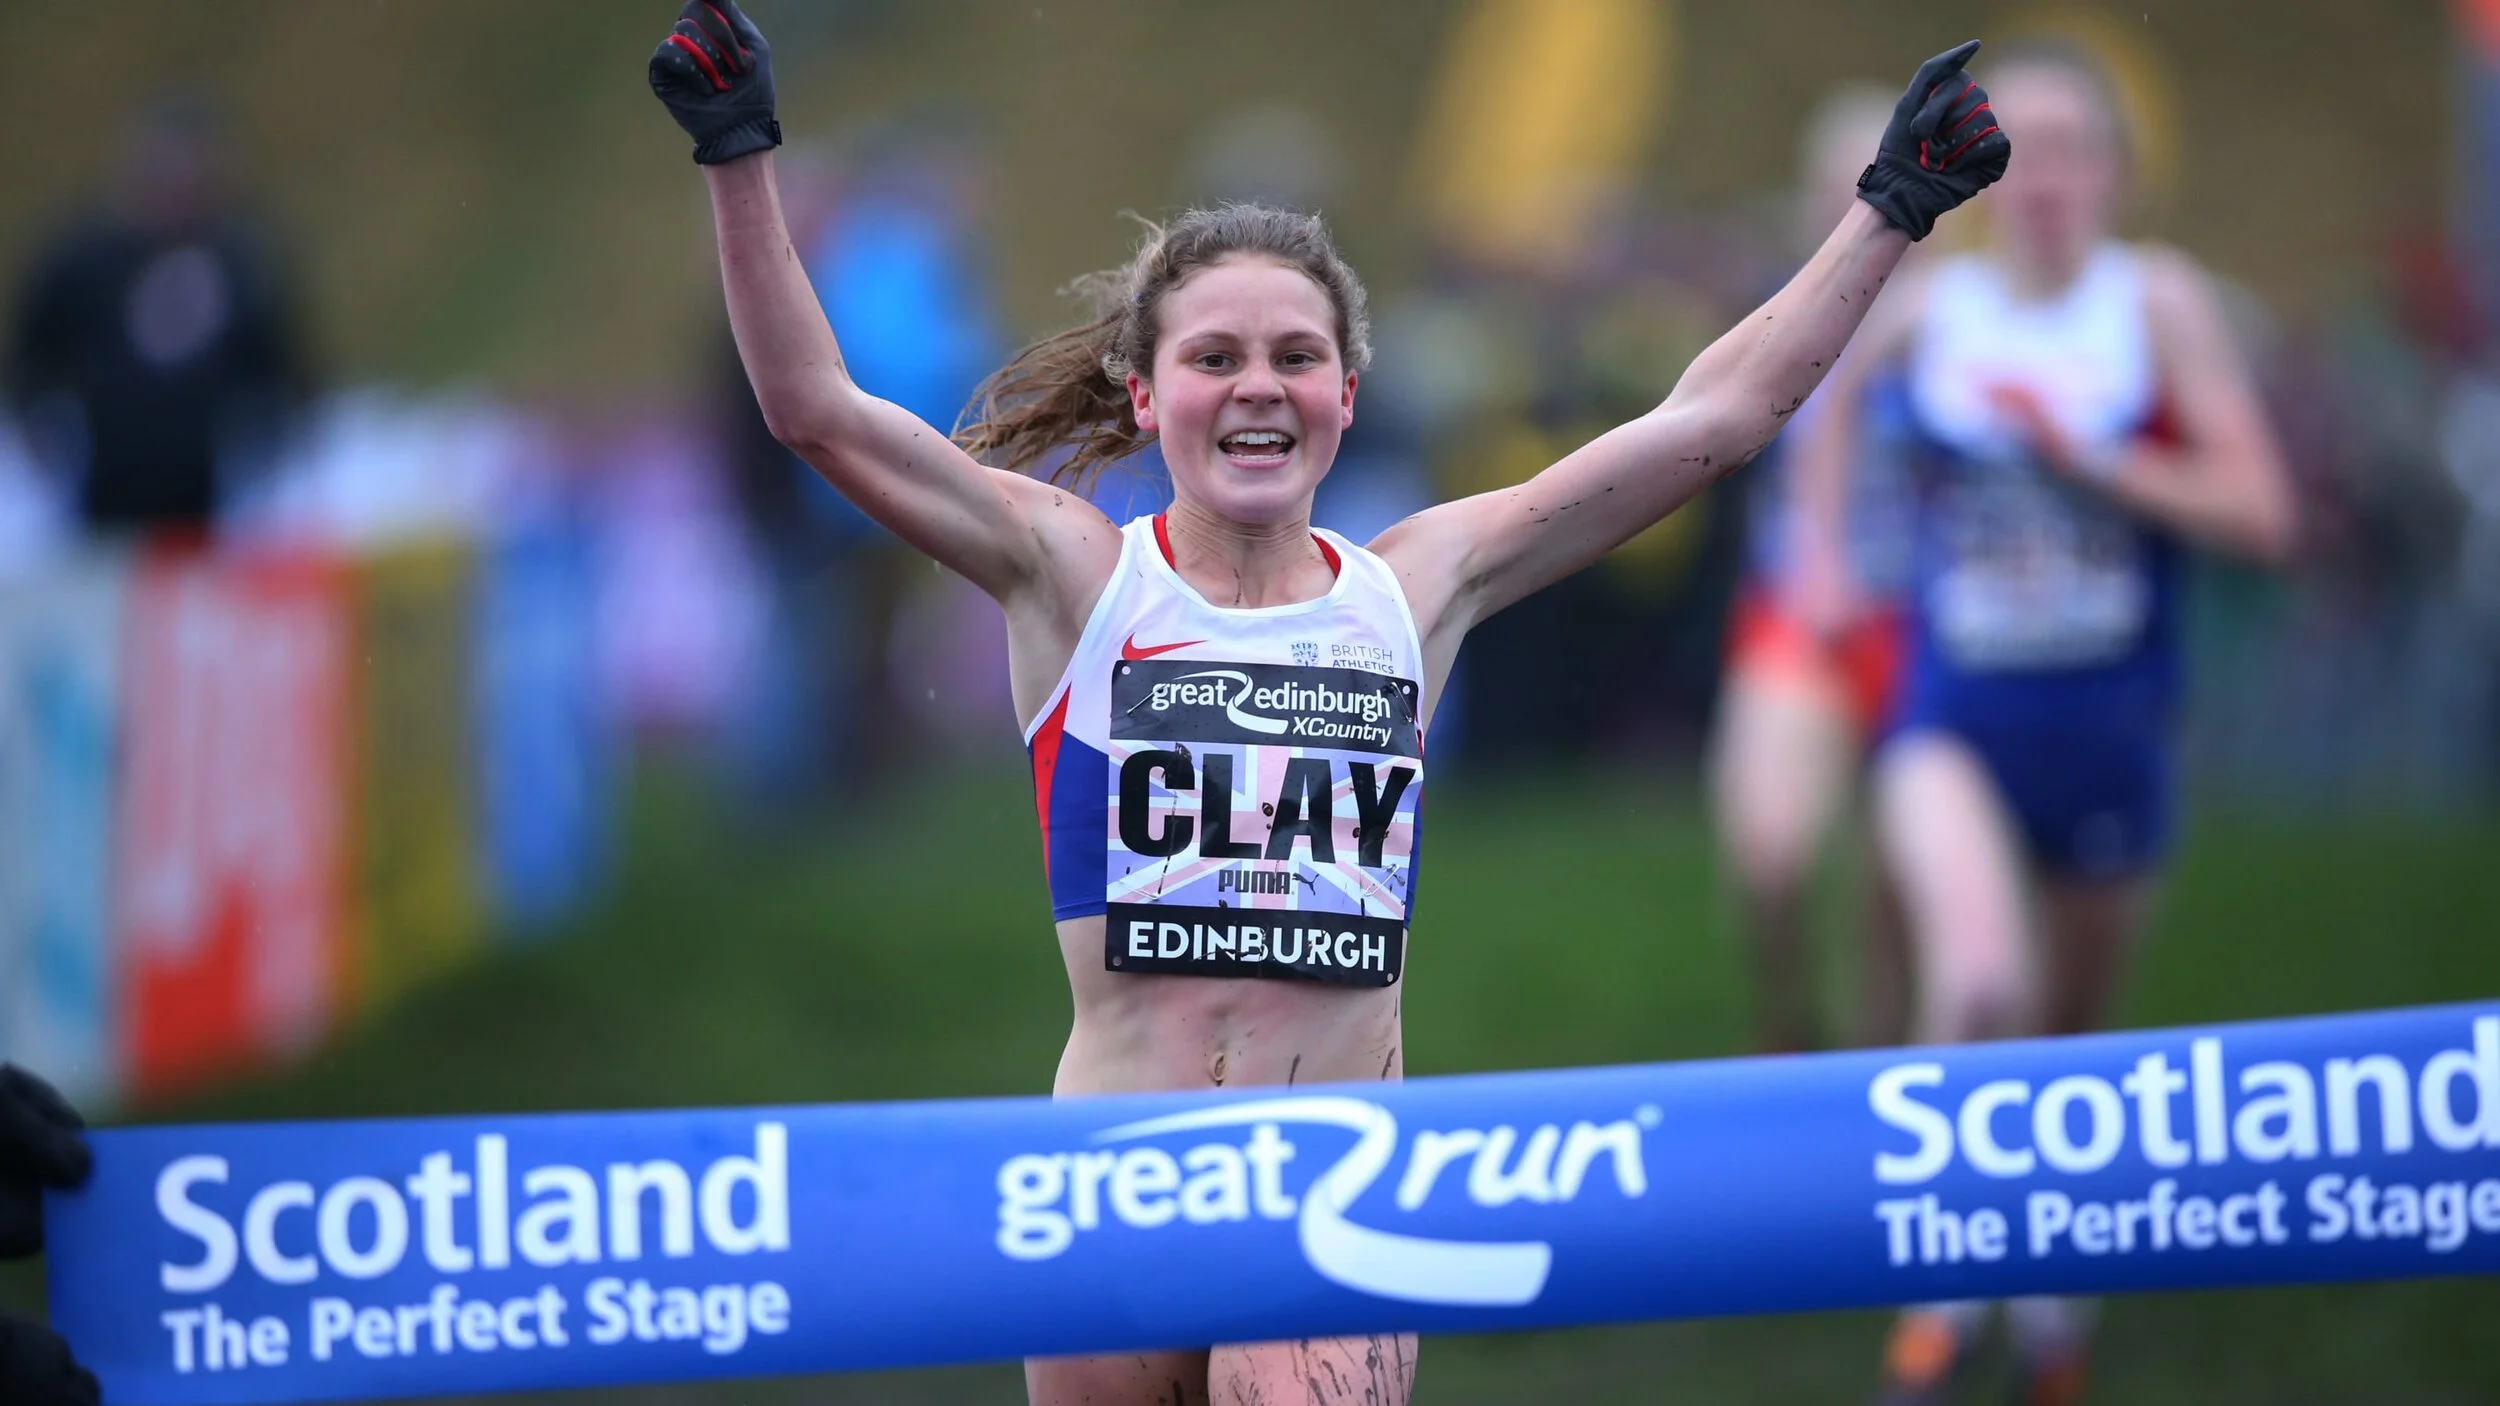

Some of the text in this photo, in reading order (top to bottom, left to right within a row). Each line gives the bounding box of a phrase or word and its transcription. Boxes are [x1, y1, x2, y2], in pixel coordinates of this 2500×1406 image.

[1331, 644, 1393, 662] BRITISH
[1332, 659, 1395, 675] ATHLETICS
[1151, 679, 1391, 722] great edinburgh
[1292, 716, 1392, 747] XCountry
[1118, 749, 1416, 868] CLAY
[1218, 869, 1290, 895] PUMA
[1128, 921, 1386, 972] EDINBURGH
[1867, 1015, 2500, 1184] Scotland
[155, 1122, 791, 1292] Scotland
[995, 1117, 1648, 1260] great run
[1874, 1171, 2500, 1266] The Perfect Stage
[162, 1277, 792, 1372] The Perfect Stage
